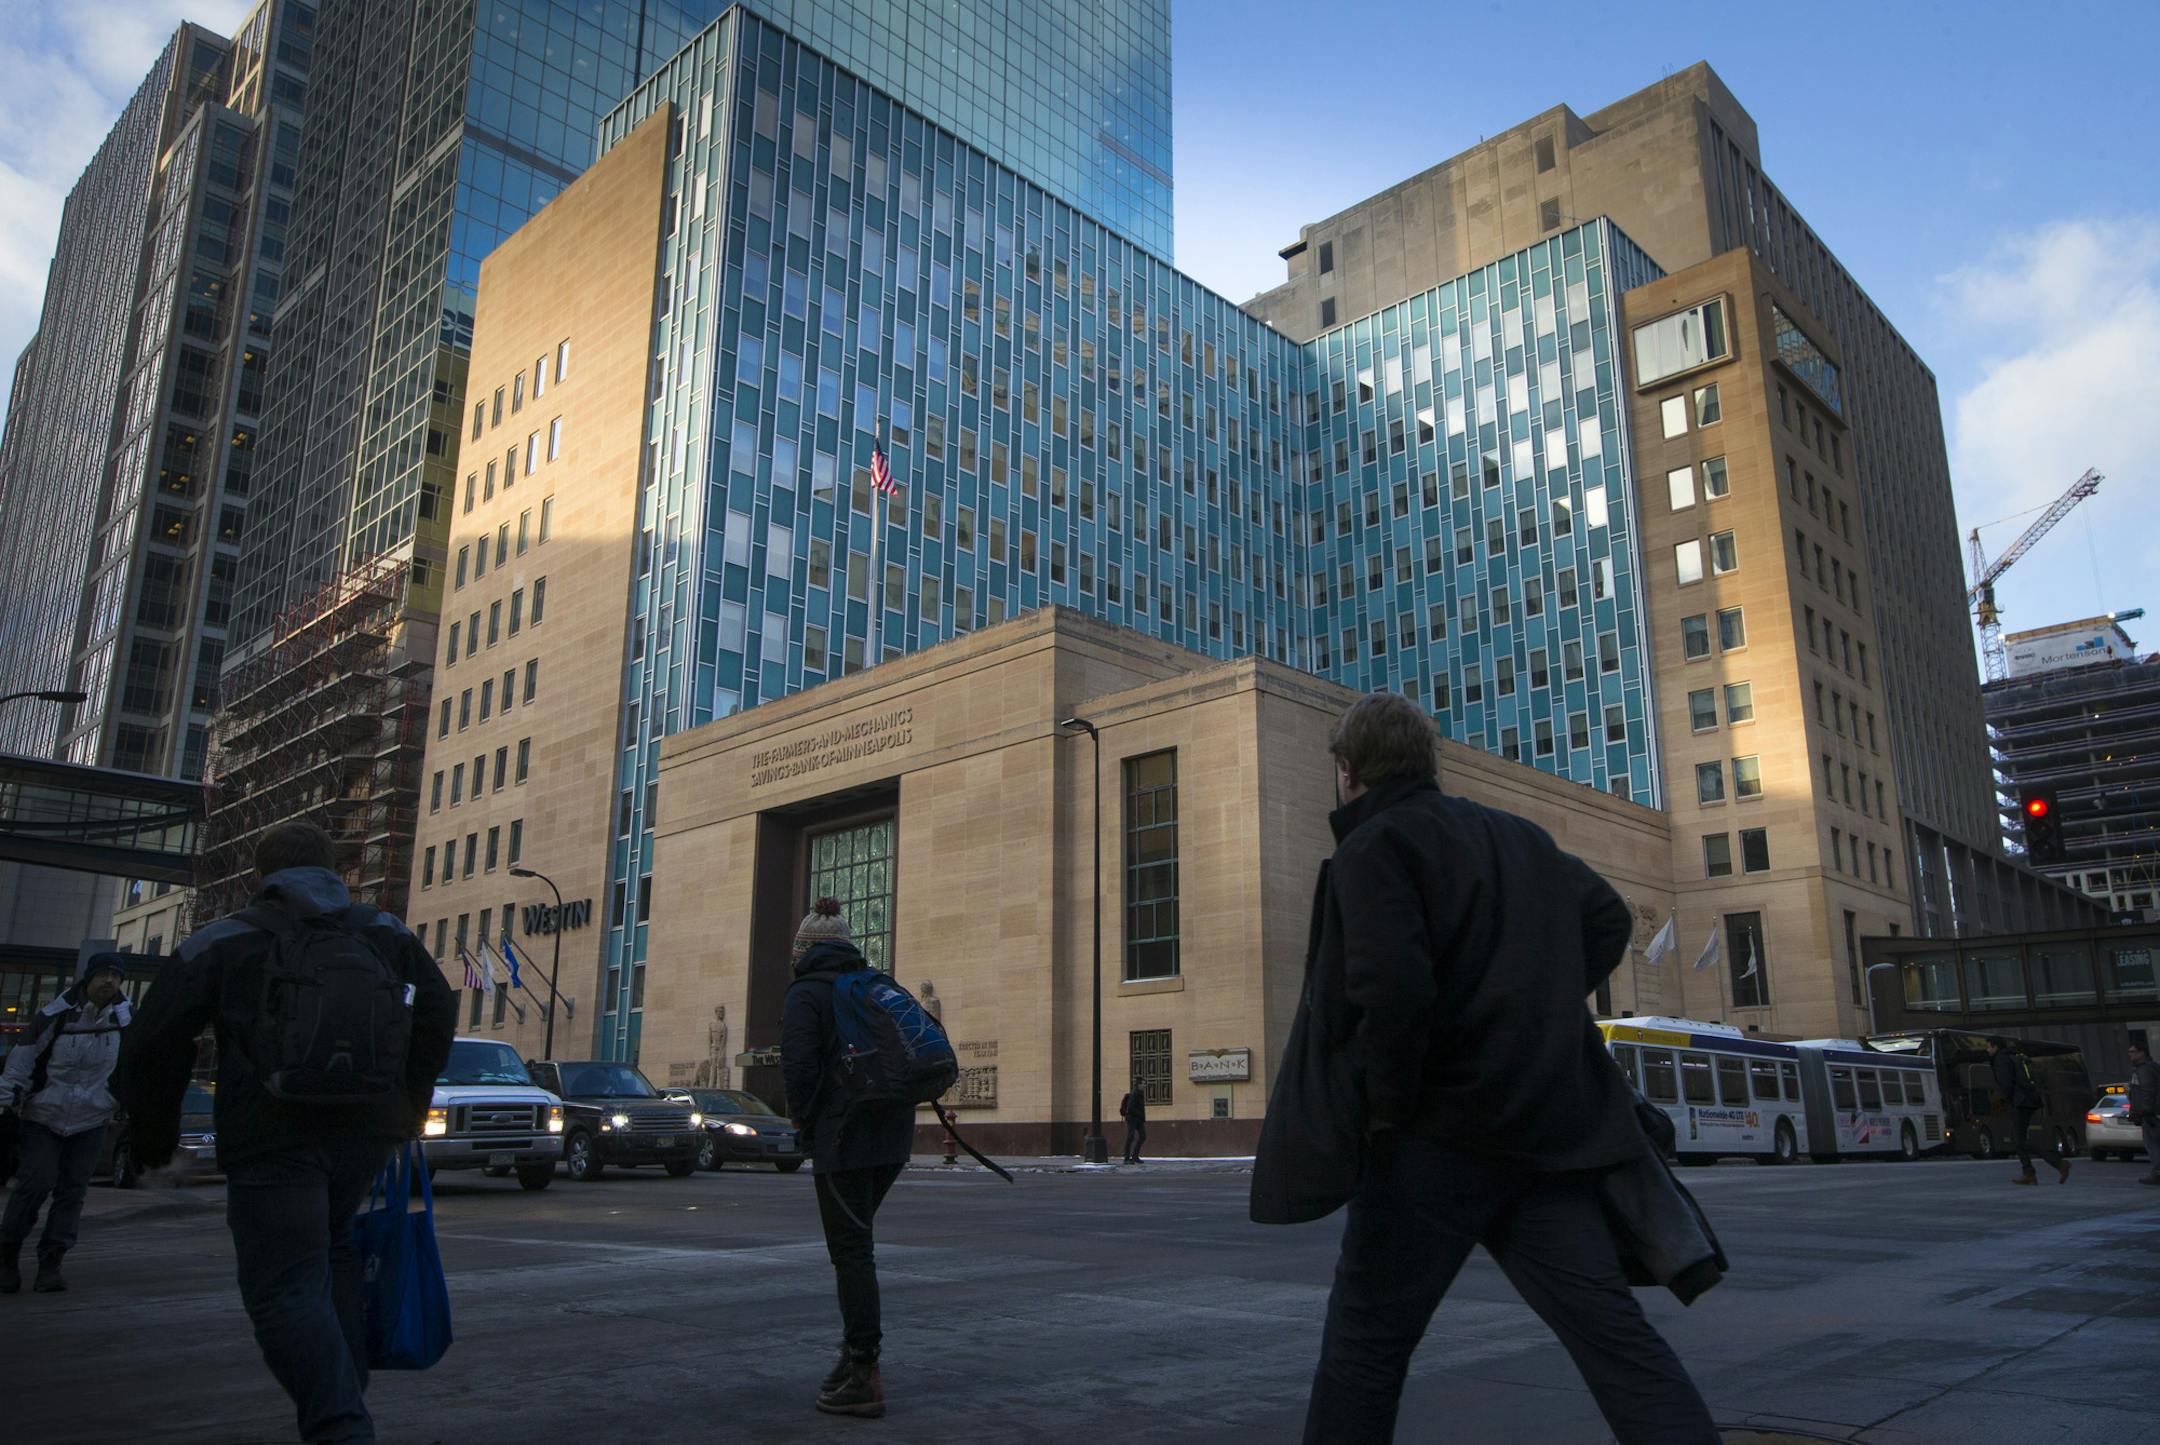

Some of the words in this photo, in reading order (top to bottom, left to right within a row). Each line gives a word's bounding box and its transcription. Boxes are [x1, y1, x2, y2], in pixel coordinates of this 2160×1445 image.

[2041, 647, 2106, 665] Mortenson
[751, 765, 790, 788] SAVINGS
[791, 755, 819, 777] BANK
[821, 750, 835, 767] OF
[836, 728, 912, 764] MINNEAPOLIS
[752, 751, 769, 769] THE
[771, 738, 816, 764] FARMERS
[818, 731, 842, 750] AND
[844, 707, 913, 742] MECHANICS
[521, 899, 592, 935] WESTIN
